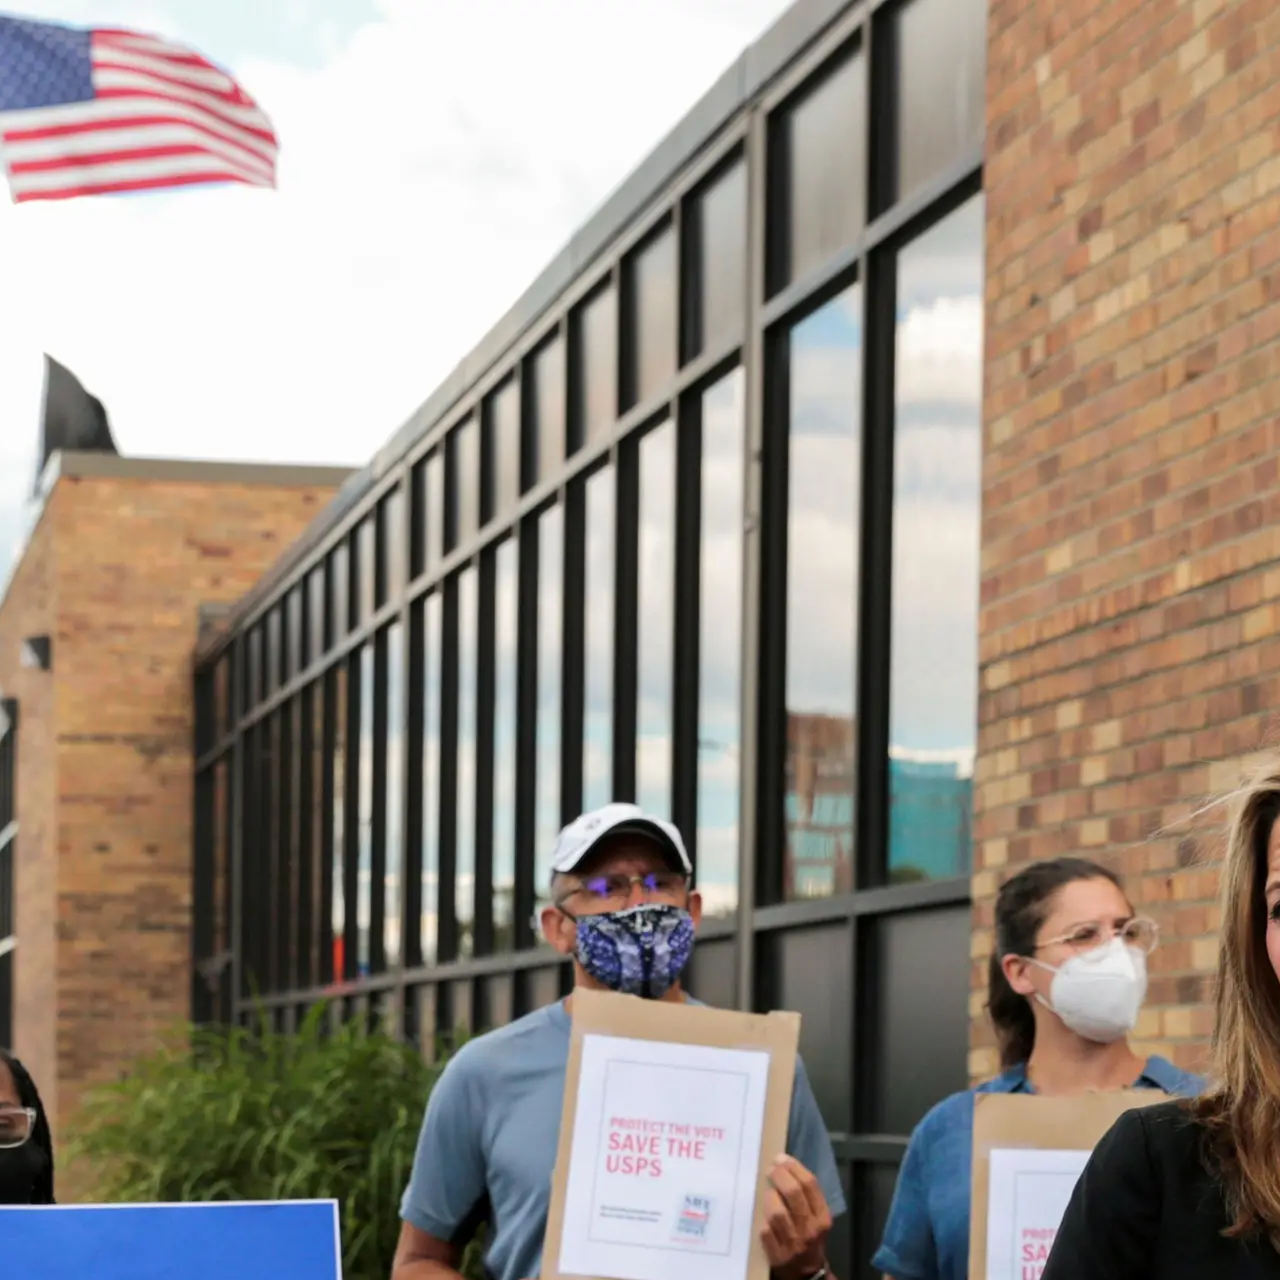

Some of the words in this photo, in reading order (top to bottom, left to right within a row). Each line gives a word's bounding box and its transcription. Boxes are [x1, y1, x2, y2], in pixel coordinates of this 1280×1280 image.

[610, 1117, 665, 1133] PROTECT
[668, 1123, 690, 1136] THE
[694, 1126, 725, 1141] VOTE
[608, 1132, 660, 1155] SAVE
[667, 1137, 705, 1160] THE
[606, 1155, 662, 1177] USPS
